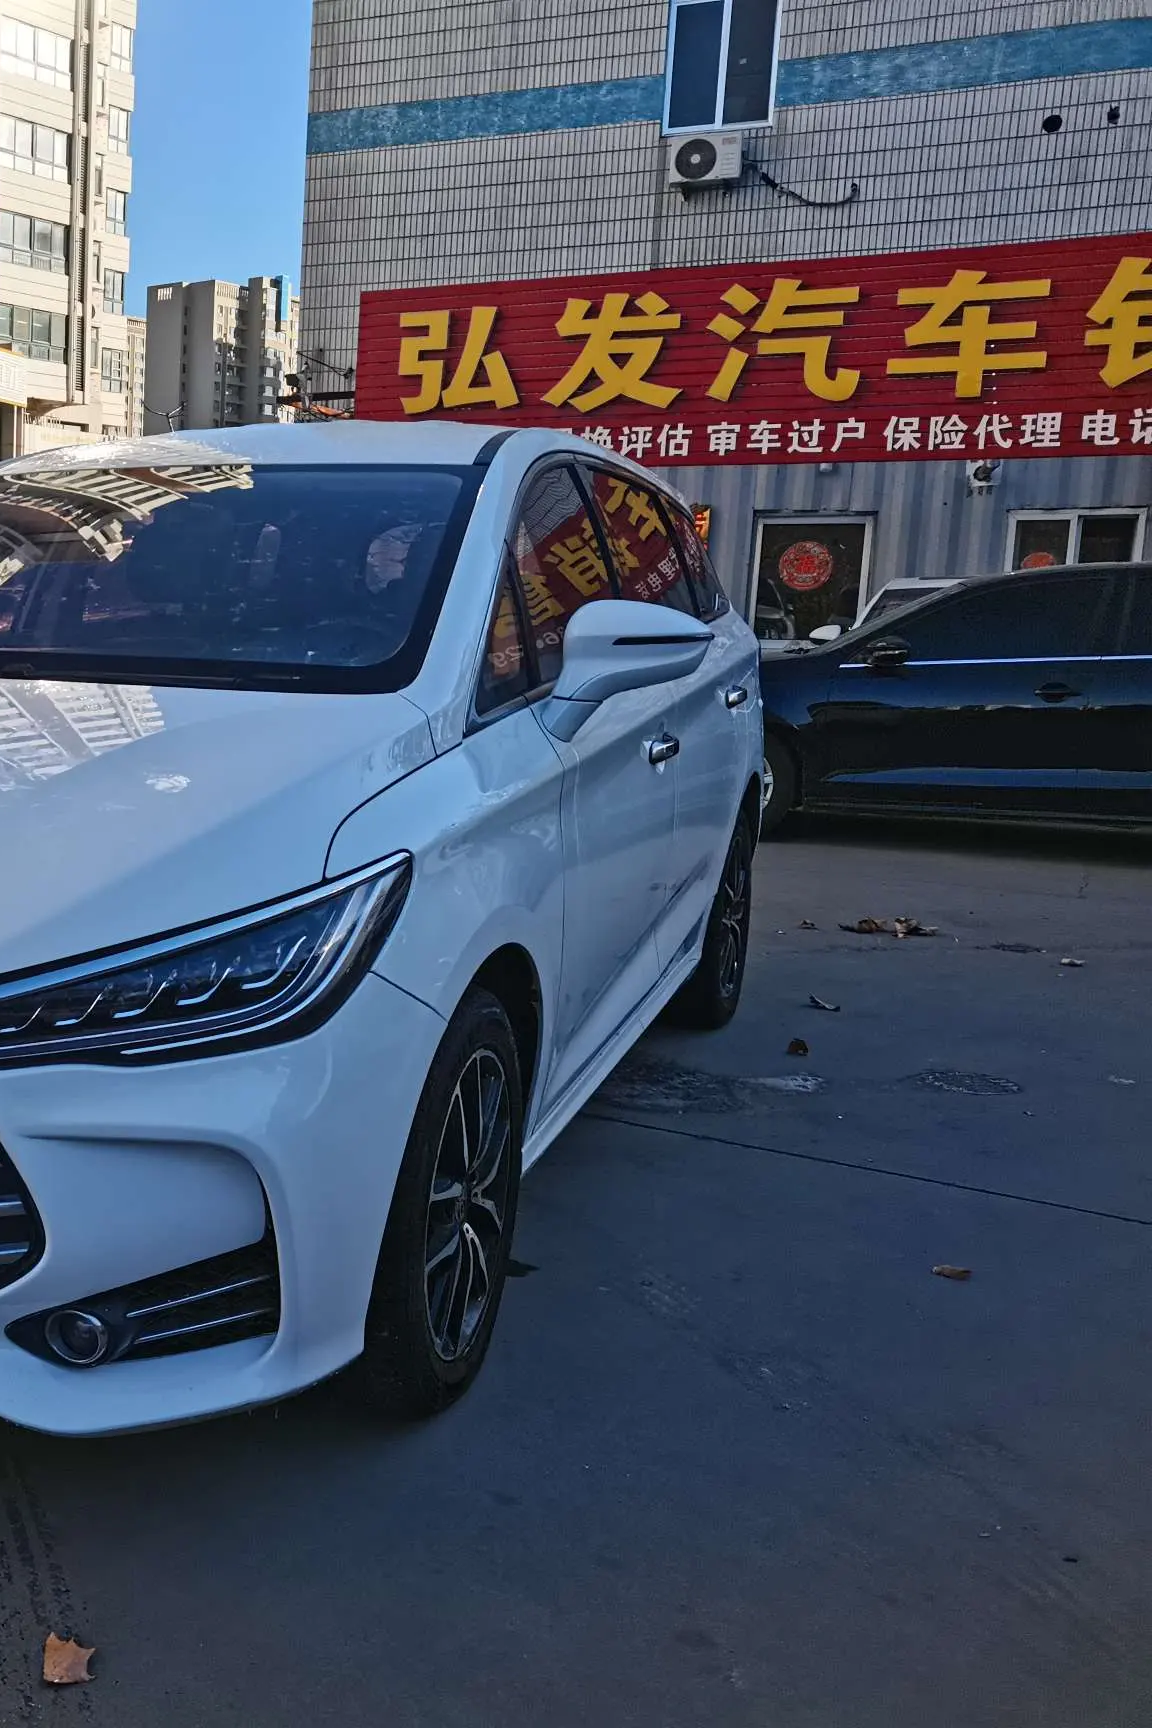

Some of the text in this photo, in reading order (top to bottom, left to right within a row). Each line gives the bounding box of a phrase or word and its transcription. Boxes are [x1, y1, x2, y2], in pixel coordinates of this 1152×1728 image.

[556, 424, 693, 458] 换评估
[707, 418, 866, 456] 审车过户
[883, 411, 1062, 451] 保险代理
